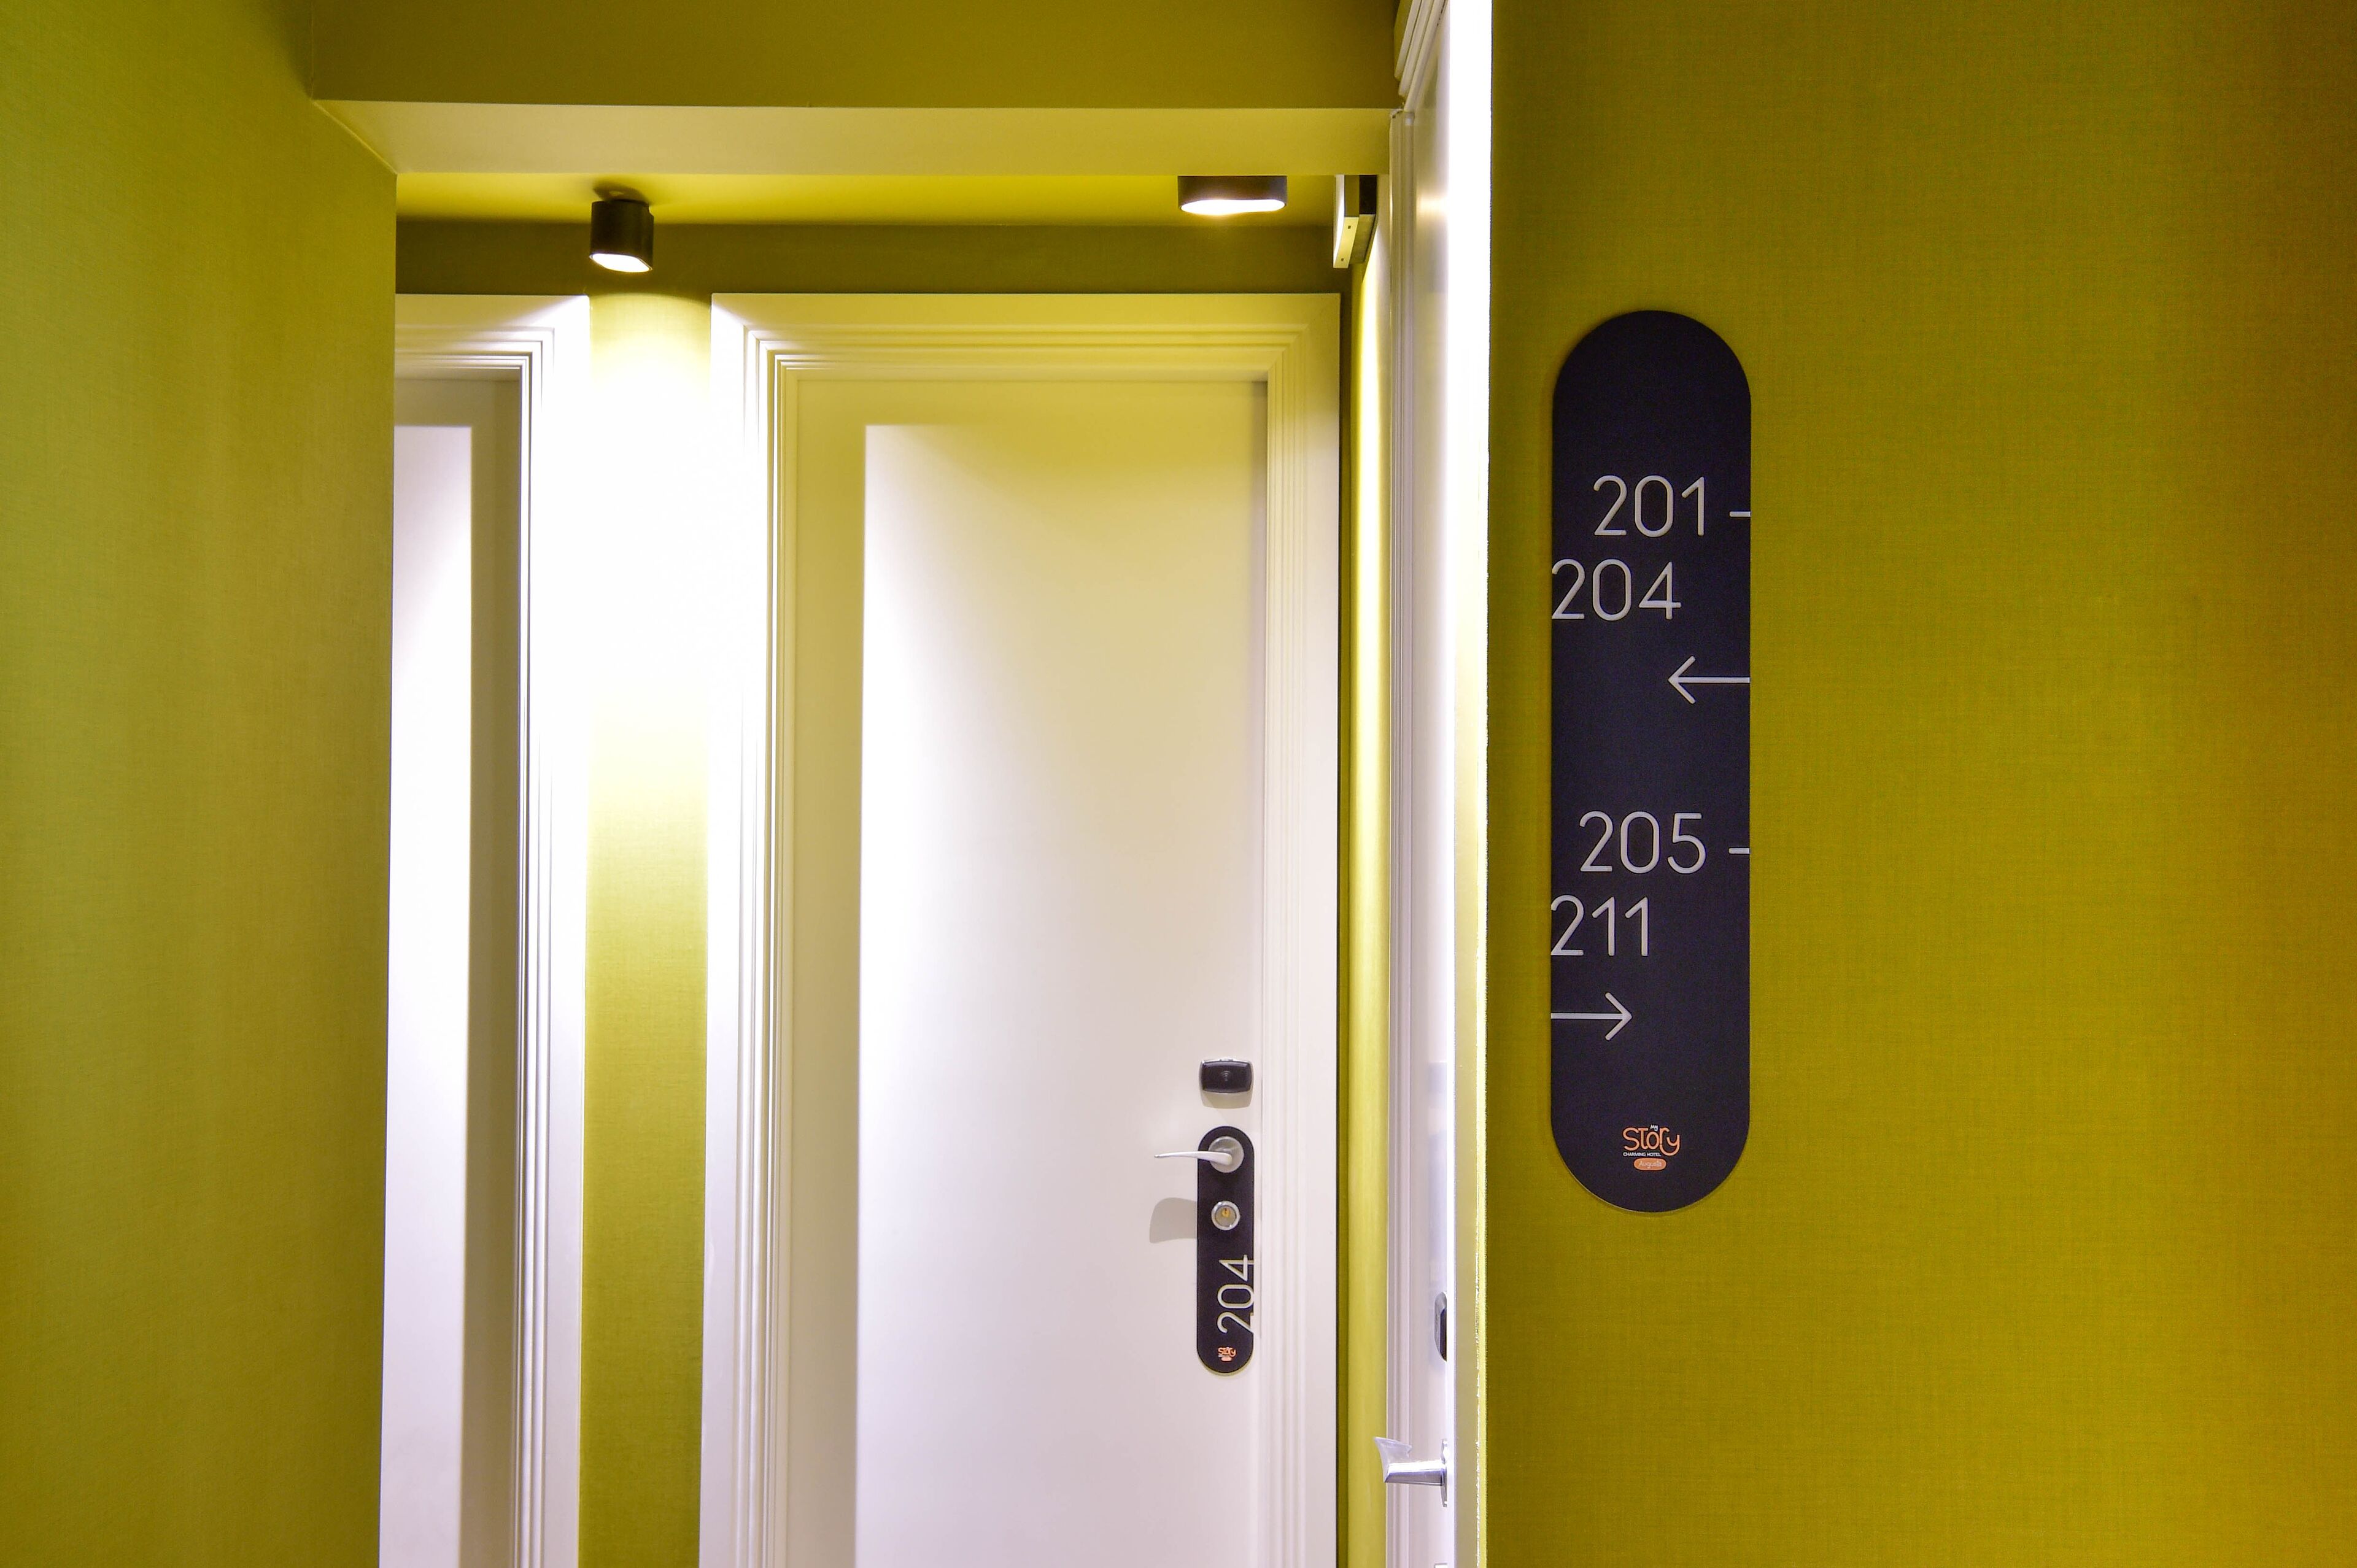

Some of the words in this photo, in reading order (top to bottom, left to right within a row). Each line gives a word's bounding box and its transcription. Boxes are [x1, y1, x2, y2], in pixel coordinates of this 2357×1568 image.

[1593, 474, 1705, 538] 201
[1551, 558, 1682, 622] 204
[1579, 810, 1706, 875] 205
[1550, 894, 1649, 957] 211
[1217, 1254, 1254, 1334] 204
